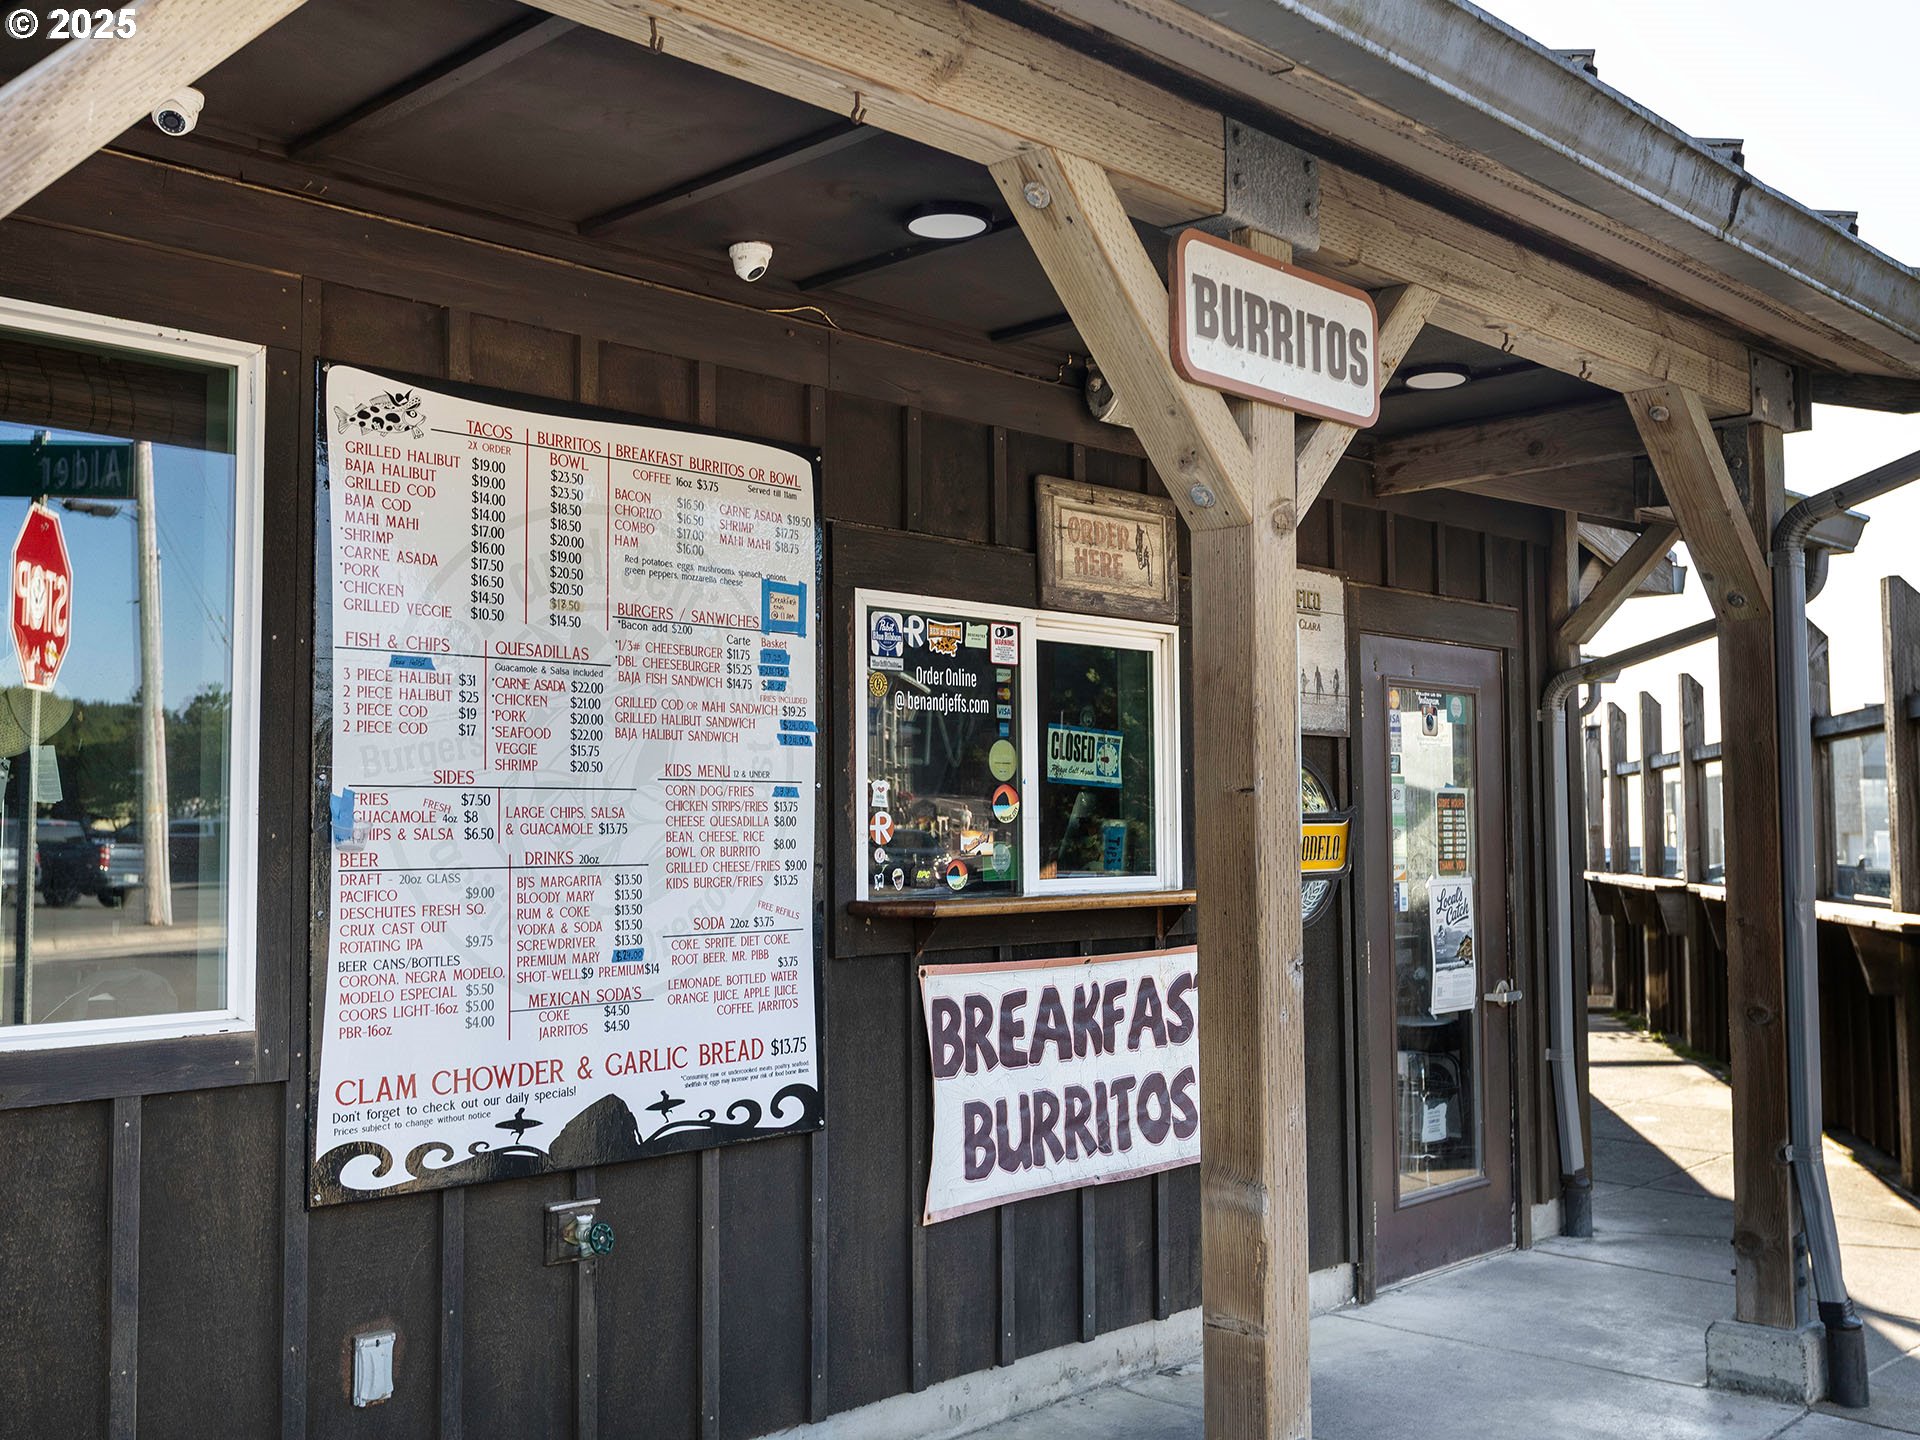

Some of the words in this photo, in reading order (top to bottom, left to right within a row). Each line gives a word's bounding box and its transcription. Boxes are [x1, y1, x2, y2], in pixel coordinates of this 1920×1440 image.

[1192, 273, 1368, 386] BURRITOS
[466, 420, 512, 439] TACOS
[468, 441, 478, 450] 2X
[482, 444, 511, 455] ORDER
[537, 431, 601, 454] BURRITOS
[345, 441, 401, 460] GRILLED
[407, 450, 461, 468] HALIBUT
[471, 458, 505, 474] $19.00
[551, 470, 583, 485] $23.50
[550, 453, 589, 471] BOWL
[616, 444, 684, 467] BREAKFAST
[689, 457, 744, 477] BURRITOS
[749, 468, 765, 481] OR
[770, 471, 800, 487] BOWL
[345, 458, 375, 474] BAJA
[382, 463, 436, 482] HALIBUT
[471, 475, 505, 490] $19.00
[551, 486, 583, 501] $23.50
[633, 469, 671, 485] COFFEE
[676, 477, 692, 489] 16oz
[697, 478, 719, 492] $3.75
[615, 489, 651, 503] BACON
[677, 498, 704, 511] $16.50
[748, 485, 771, 496] Served
[774, 489, 782, 497] till
[615, 505, 662, 520] CHORIZO
[677, 513, 704, 526] $16.50
[345, 511, 379, 525] MAHI
[386, 515, 419, 530] MAHI
[471, 524, 505, 539] $17.00
[551, 534, 584, 549] $20.00
[614, 520, 654, 535] COMBO
[677, 528, 704, 541] $17.00
[720, 520, 754, 533] SHRIMP
[775, 527, 799, 540] $17.75
[1068, 516, 1131, 550] ORDER
[615, 535, 639, 547] HAM
[677, 543, 704, 557] $16.00
[720, 535, 744, 547] MAHI
[747, 539, 771, 551] MAHI
[775, 542, 799, 554] $18.75
[1074, 548, 1124, 577] HERE
[625, 567, 645, 576] green
[682, 573, 716, 583] mozzarella
[720, 579, 742, 587] cheese
[343, 598, 399, 614] GRILLED
[407, 604, 452, 618] VEGGIE
[471, 609, 504, 622] $10.50
[550, 614, 581, 628] $14.50
[618, 602, 673, 620] BURGERS
[679, 608, 685, 620] /
[692, 610, 759, 628] SANWICHES
[878, 619, 894, 632] Pabst
[345, 632, 380, 647] FISH
[387, 635, 398, 648] &
[406, 636, 450, 652] CHIPS
[727, 635, 750, 646] Carte
[761, 638, 787, 649] Basket
[872, 632, 883, 640] Blue
[885, 632, 901, 641] Ribbon
[495, 641, 589, 661] QUESADILLAS
[344, 667, 350, 679] 3
[357, 669, 392, 682] PIECE
[399, 671, 452, 685] HALIBUT
[459, 674, 476, 687] $31
[495, 663, 538, 674] Guacamole
[550, 666, 570, 676] Salsa
[573, 669, 603, 677] included
[916, 666, 943, 685] Order
[946, 668, 977, 688] Online
[344, 685, 350, 697] 2
[357, 687, 392, 699] PIECE
[399, 689, 452, 702] HALIBUT
[459, 691, 479, 703] $25
[895, 691, 905, 710] @
[907, 691, 989, 716] benandjeffs.com
[998, 707, 1010, 715] VISA
[1052, 731, 1095, 763] CLOSED
[433, 770, 475, 784] SIDES
[665, 764, 691, 777] KIDS
[698, 765, 730, 776] MENU
[749, 771, 770, 779] UNDER
[354, 793, 388, 806] FRIES
[461, 794, 491, 806] $7.50
[665, 801, 708, 812] CHICKEN
[712, 801, 768, 812] STRIPS/FRIES
[774, 801, 798, 812] $13.75
[1438, 798, 1450, 808] STORE
[1451, 798, 1464, 808] HOURS
[525, 851, 574, 865] DRINKS
[579, 855, 599, 864] 20oz
[1302, 835, 1340, 861] ODELO
[340, 853, 378, 867] BEER
[1440, 861, 1454, 870] THANK
[1457, 861, 1465, 870] YOU
[517, 876, 535, 889] BJ'S
[541, 875, 601, 887] MARGARITA
[614, 874, 642, 885] $13.50
[340, 890, 397, 902] PACIFICO
[465, 887, 494, 899] $9.00
[1436, 886, 1463, 914] Local's
[758, 900, 773, 912] FREE
[776, 906, 800, 920] REFILLS
[1446, 902, 1469, 925] Catch
[694, 917, 725, 930] SODA
[730, 918, 749, 928] 22oz
[754, 916, 774, 927] $3.75
[528, 991, 590, 1008] MEXICAN
[596, 986, 642, 1002] SODA'S
[539, 1024, 588, 1041] JARRITOS
[604, 1020, 629, 1032] $4.50
[932, 970, 1198, 1080] BREAKFAS
[335, 1074, 417, 1106] CLAM
[432, 1059, 564, 1095] CHOWDER
[577, 1056, 592, 1080] &
[605, 1046, 687, 1075] GARLIC
[700, 1038, 763, 1066] BREAD
[771, 1037, 807, 1056] $13.75
[333, 1111, 360, 1124] Don't
[367, 1107, 400, 1121] forget
[407, 1106, 417, 1116] to
[423, 1101, 455, 1113] check
[461, 1098, 478, 1109] out
[484, 1096, 500, 1107] our
[506, 1092, 529, 1107] daily
[535, 1087, 577, 1102] specials!
[333, 1126, 358, 1136] Prices
[362, 1123, 390, 1134] subject
[395, 1121, 402, 1129] to
[405, 1118, 433, 1129] change
[438, 1114, 465, 1124] without
[469, 1111, 491, 1122] notice
[963, 1066, 1198, 1182] BURRITOS
